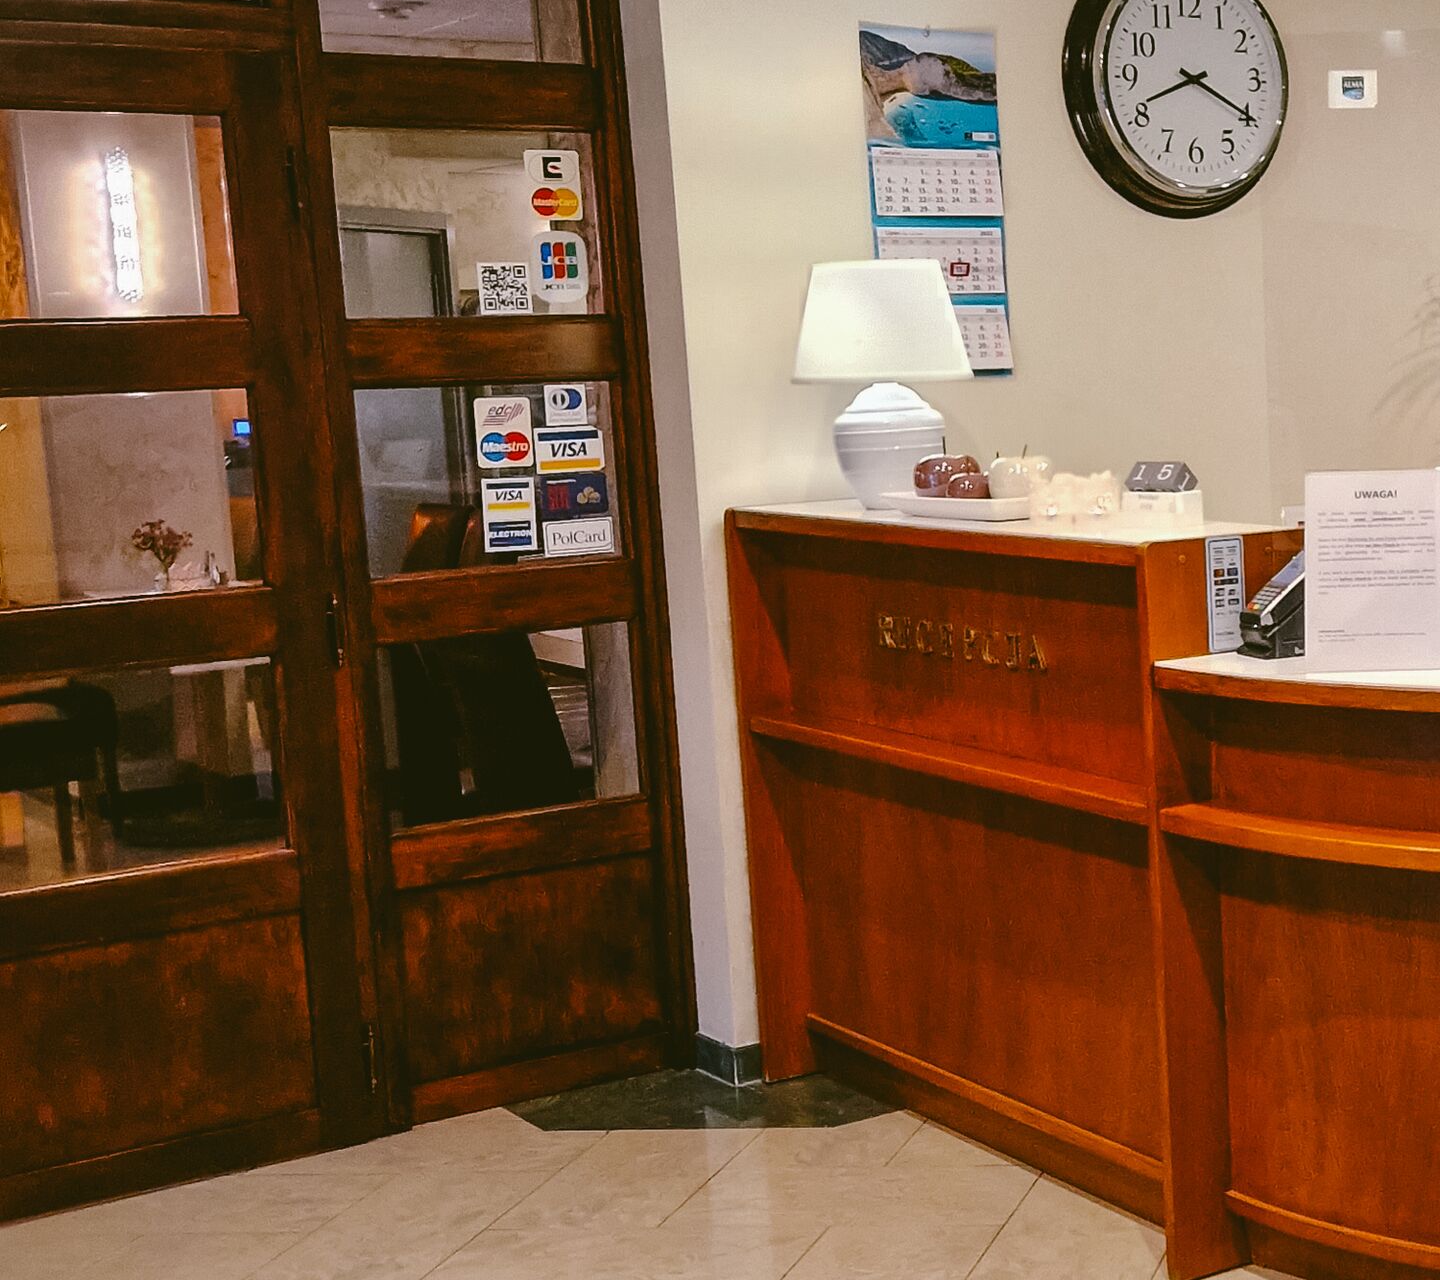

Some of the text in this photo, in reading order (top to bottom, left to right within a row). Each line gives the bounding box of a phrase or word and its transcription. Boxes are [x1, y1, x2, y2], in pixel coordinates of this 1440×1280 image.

[1153, 4, 1172, 28] 11
[1215, 5, 1223, 30] 1
[1132, 32, 1155, 57] 10
[1234, 29, 1248, 53] 2
[1122, 63, 1138, 90] 9
[1249, 67, 1261, 92] 3
[1134, 102, 1150, 128] 8
[1238, 103, 1257, 127] 4
[1161, 129, 1174, 152] 7
[1188, 137, 1204, 164] 6
[1221, 129, 1235, 154] 5
[482, 440, 529, 453] Maestro
[551, 441, 588, 458] VISA
[1132, 464, 1175, 481] 1 5
[495, 489, 523, 501] VISA
[1354, 489, 1398, 499] UWAGA!
[490, 528, 532, 539] ELECTRON
[552, 528, 607, 546] PolCard
